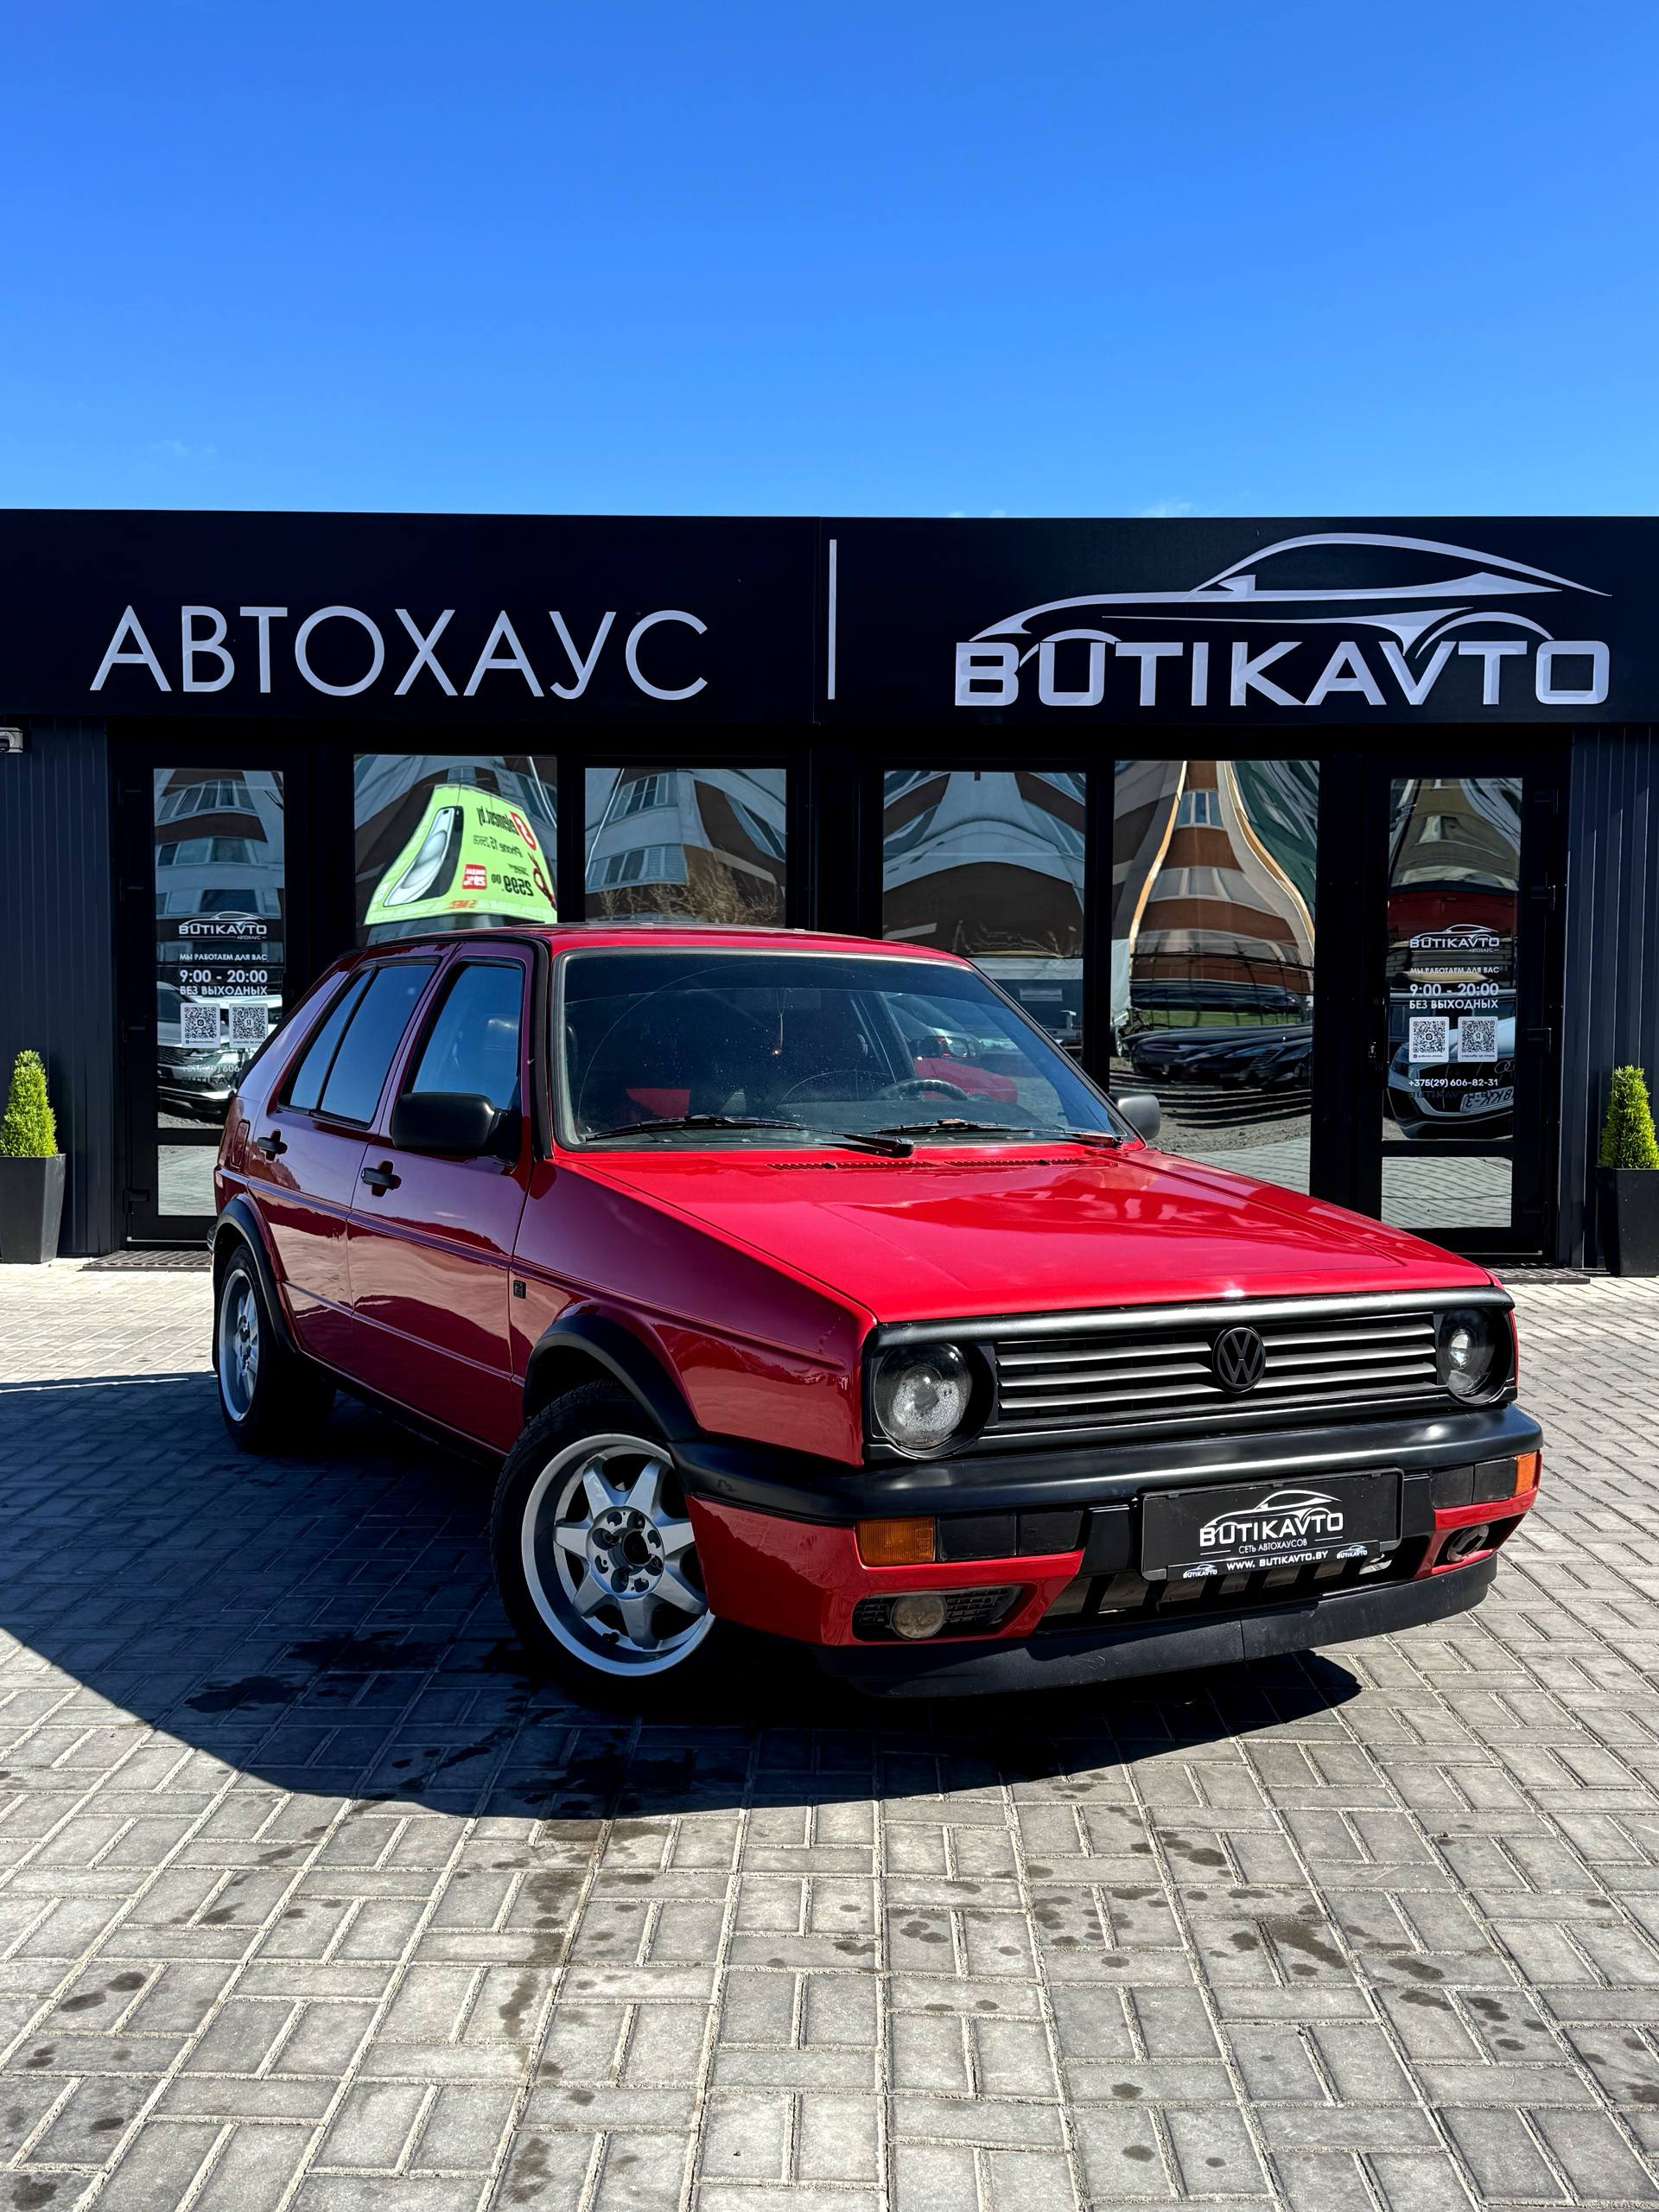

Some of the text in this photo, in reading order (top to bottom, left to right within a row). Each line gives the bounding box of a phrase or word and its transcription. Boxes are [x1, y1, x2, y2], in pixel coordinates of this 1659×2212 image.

[90, 604, 708, 701] АВТОХАУС
[955, 639, 1611, 707] BUTIKAVTO
[179, 925, 268, 935] BUTIKAVTO
[1409, 938, 1500, 949] BUTIKAVTO
[234, 953, 250, 962] ДЛЯ
[180, 969, 212, 983] 9:00
[226, 969, 268, 983] 20:00
[180, 985, 268, 995] БЕЗ ВЫХОДНЫХ
[1409, 983, 1442, 997] 9:00
[1457, 982, 1499, 996] 20:00
[1409, 999, 1499, 1010] БЕЗ ВЫХОДНЫХ
[1408, 1078, 1499, 1088] +375(29) 606-82-31
[1199, 1512, 1344, 1548] BUTIKAVTO
[1238, 1538, 1307, 1554] СЕТЬ АВТОХАУСОВ
[1227, 1550, 1329, 1571] WWW. BUTIKAVTO.BY
[1183, 1568, 1218, 1579] BUTIKAVTO
